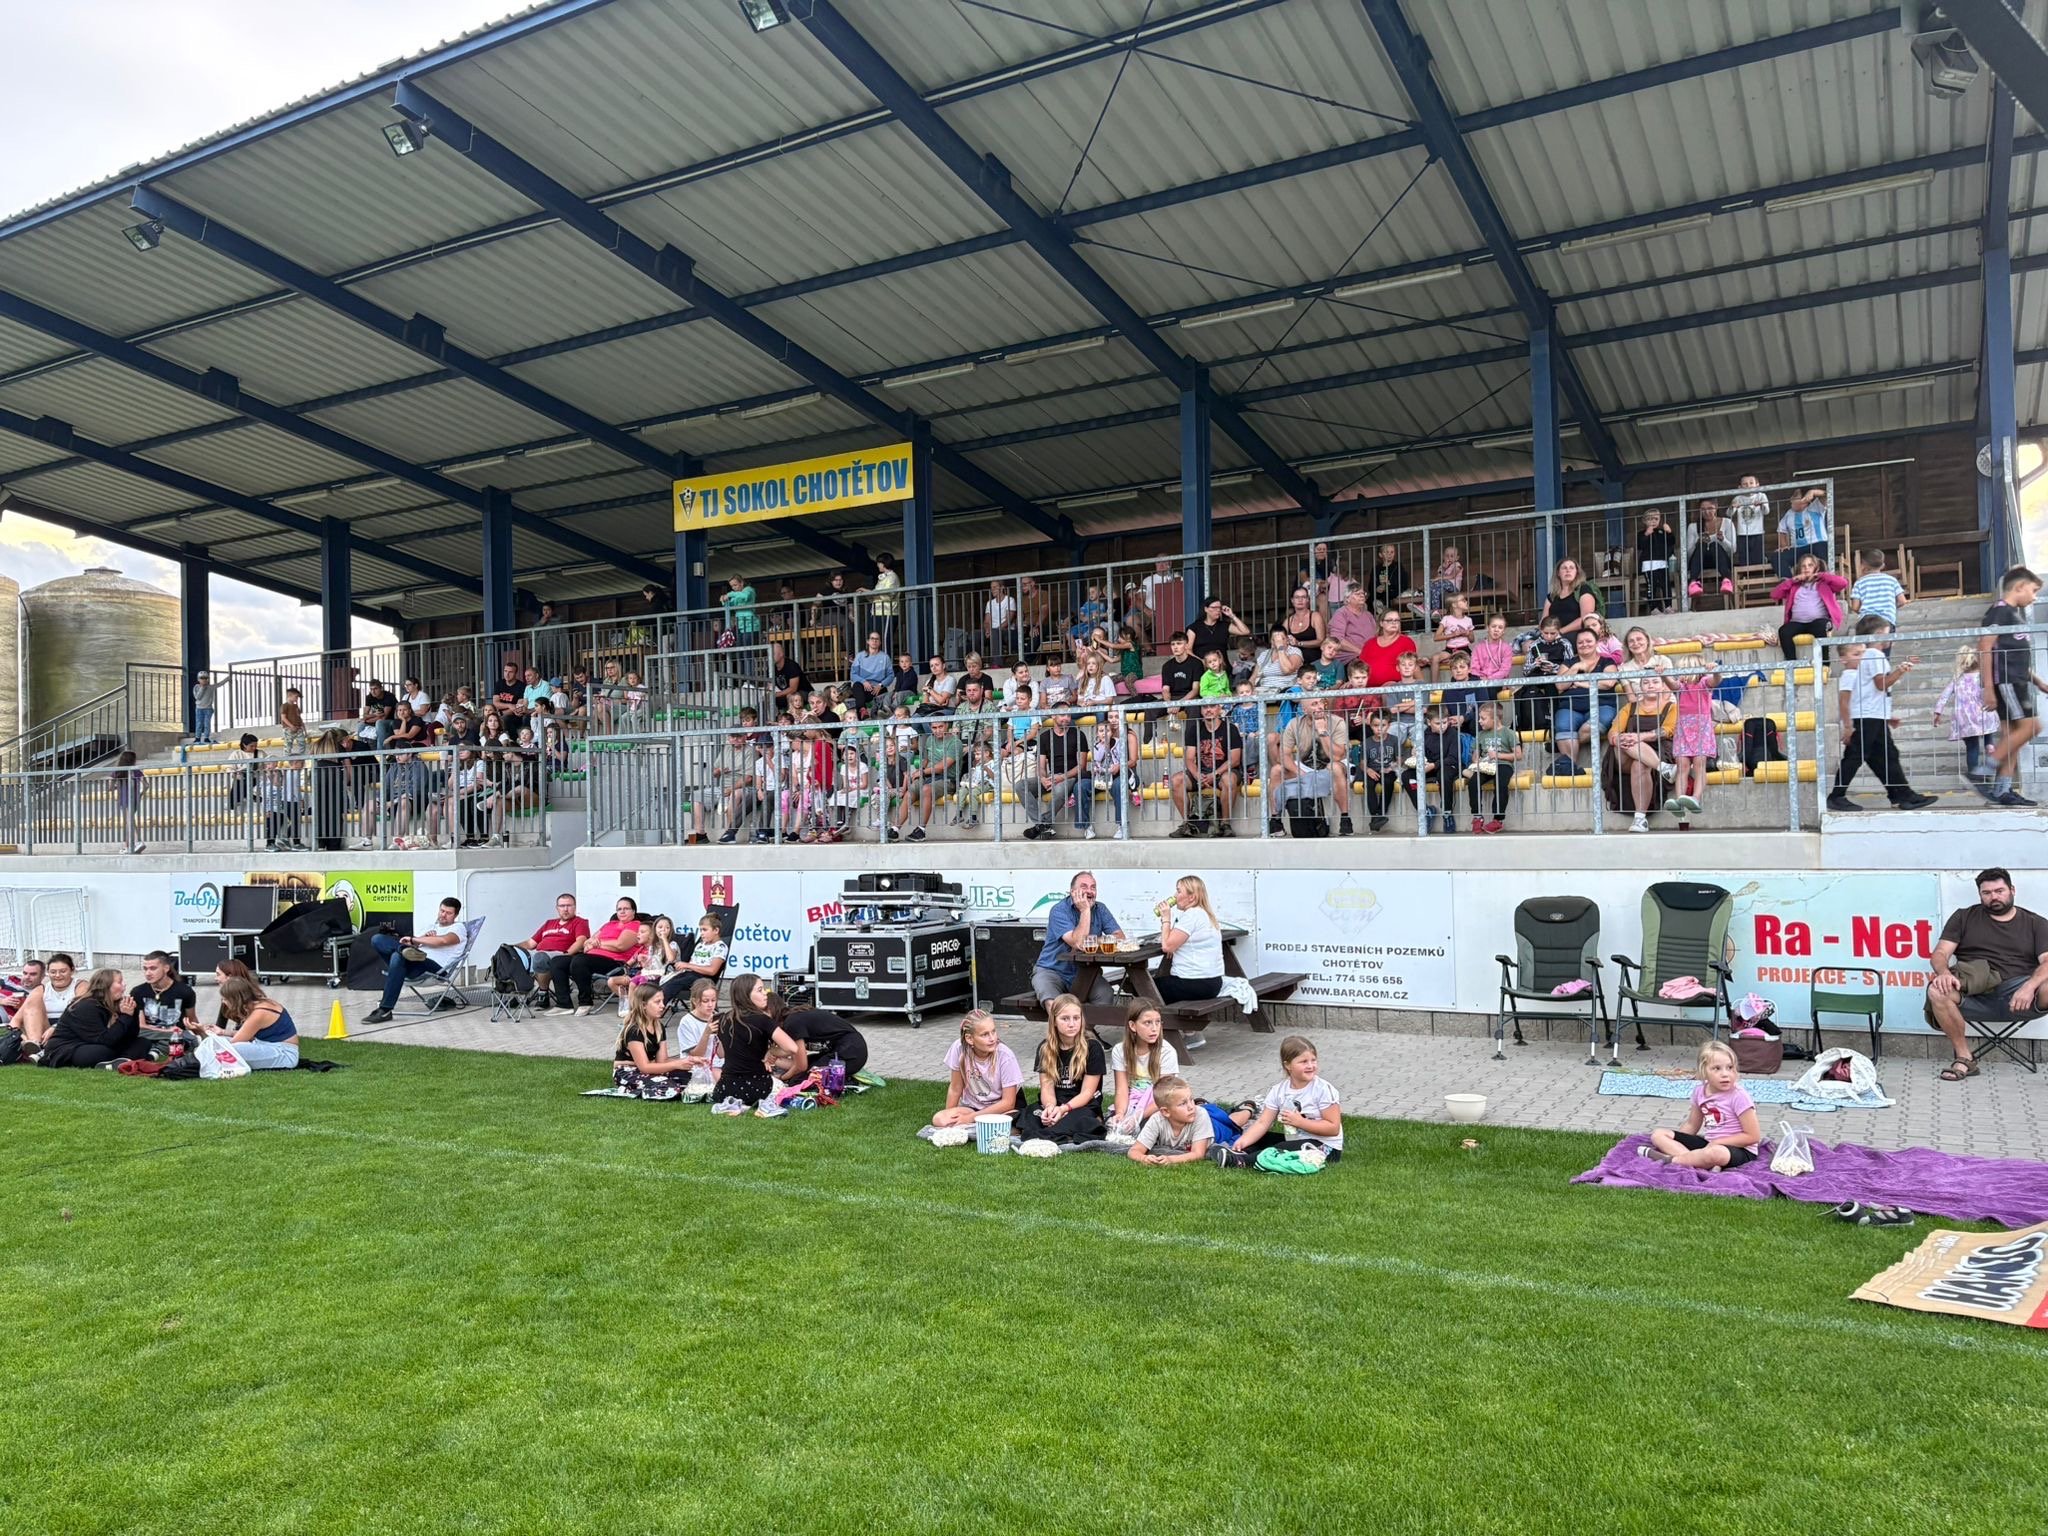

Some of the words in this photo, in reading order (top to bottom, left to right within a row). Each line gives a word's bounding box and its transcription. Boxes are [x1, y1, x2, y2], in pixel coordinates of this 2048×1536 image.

[700, 488, 719, 518] TJ
[724, 478, 790, 515] SOKOL
[793, 458, 908, 505] CHOTĚTOV
[366, 882, 408, 894] KOMINÍK
[734, 923, 792, 942] otětov
[1754, 914, 1812, 956] Ra
[1823, 935, 1840, 944] -
[1851, 915, 1933, 959] Net
[930, 939, 960, 955] BARCO
[1265, 943, 1308, 953] PRODEJ
[1311, 943, 1383, 955] STAVEBNÍCH
[1386, 945, 1445, 957] POZEMKŮ
[743, 953, 789, 972] sport
[931, 959, 945, 970] UDX
[945, 956, 962, 968] series
[1305, 972, 1332, 982] TEL.:
[1335, 974, 1355, 983] 774
[1359, 974, 1379, 984] 556
[1757, 966, 1846, 985] PROJEKCE
[1300, 986, 1409, 1000] WWW.BARACOM.CZ
